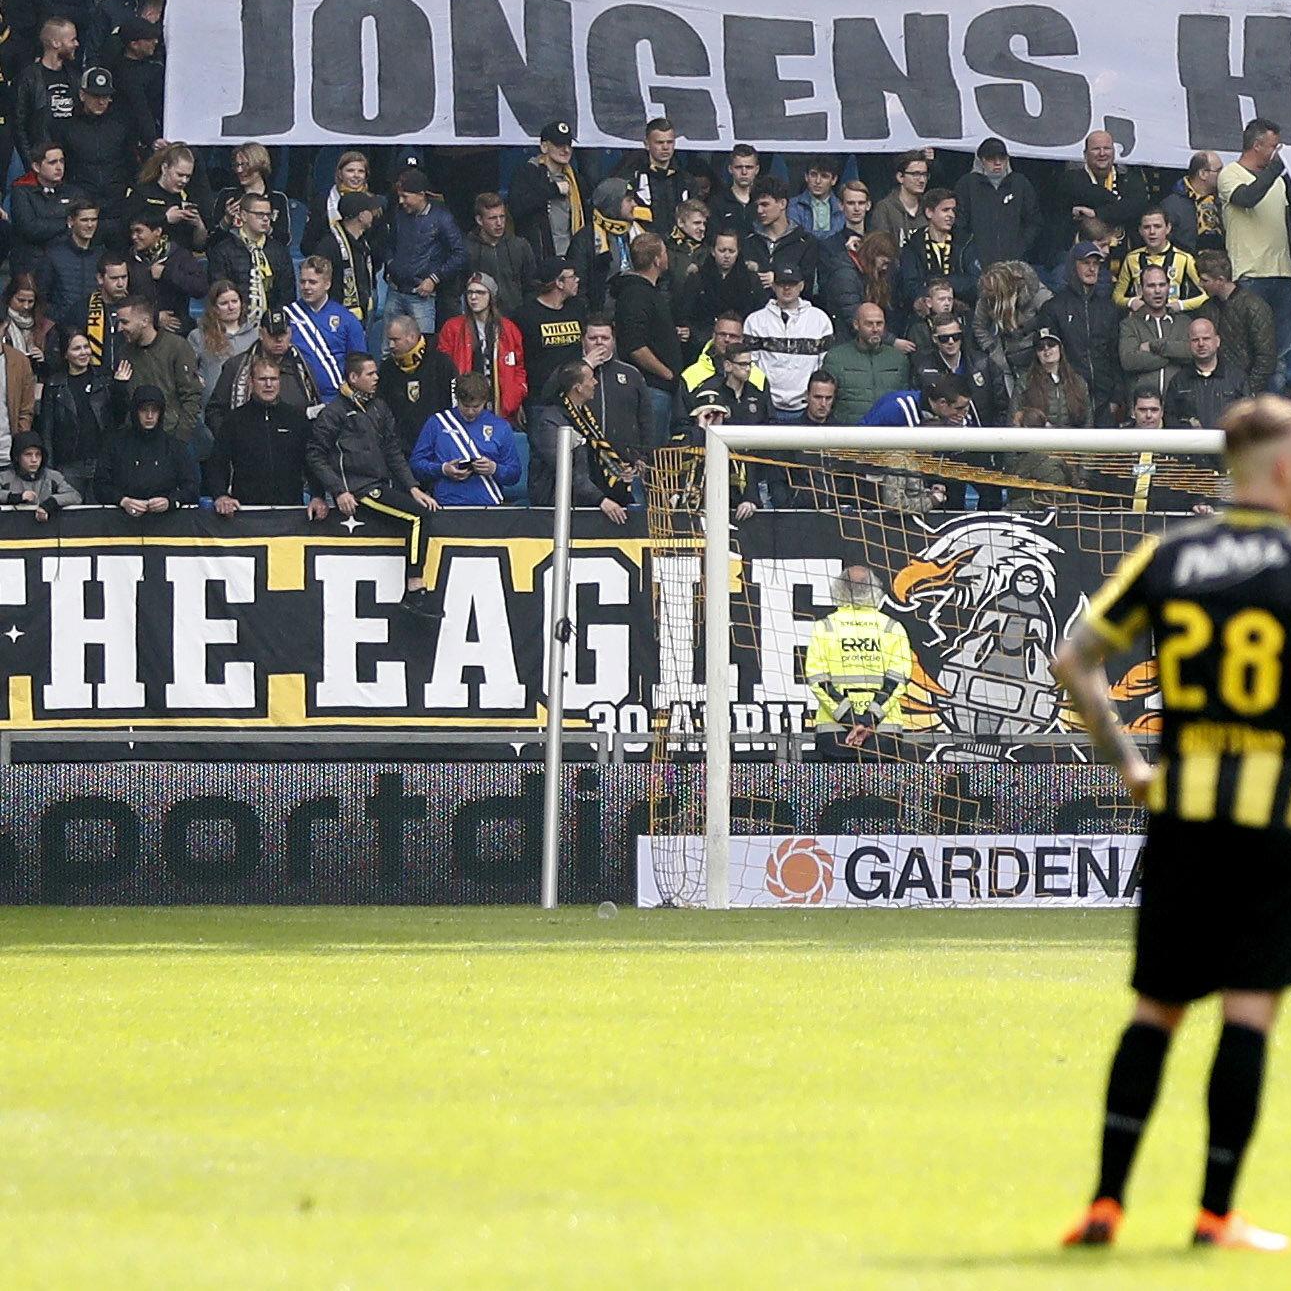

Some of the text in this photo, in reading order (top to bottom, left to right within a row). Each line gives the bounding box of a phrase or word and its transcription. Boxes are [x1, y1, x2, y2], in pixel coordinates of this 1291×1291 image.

[0, 555, 256, 710] HE
[314, 554, 846, 710] EAGLE
[1160, 602, 1287, 716] 28
